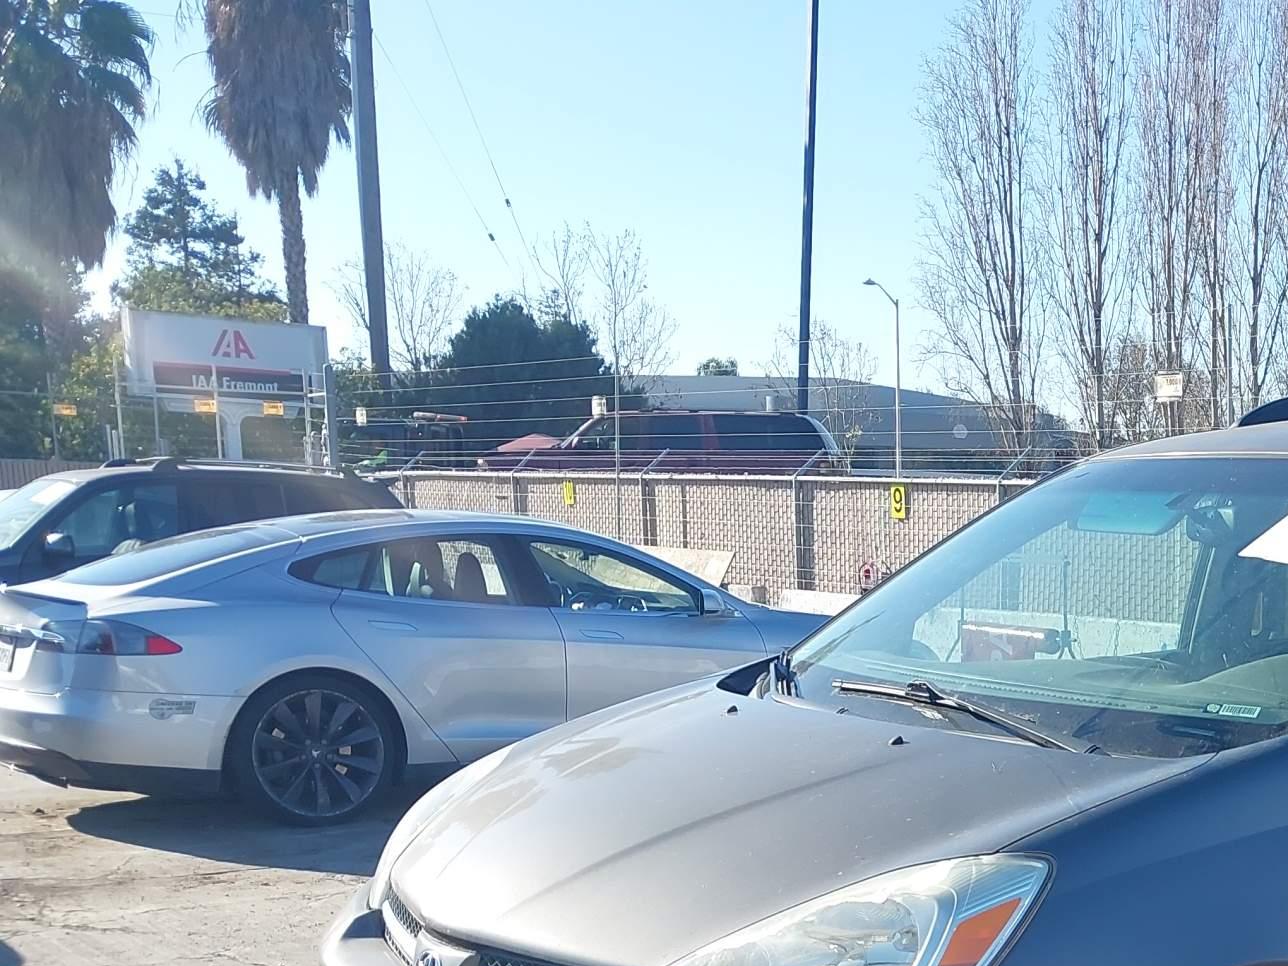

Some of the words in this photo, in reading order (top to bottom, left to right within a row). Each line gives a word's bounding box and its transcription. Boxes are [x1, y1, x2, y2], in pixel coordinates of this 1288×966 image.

[192, 374, 218, 390] IAA
[222, 376, 278, 393] Fremont
[893, 487, 903, 513] 9
